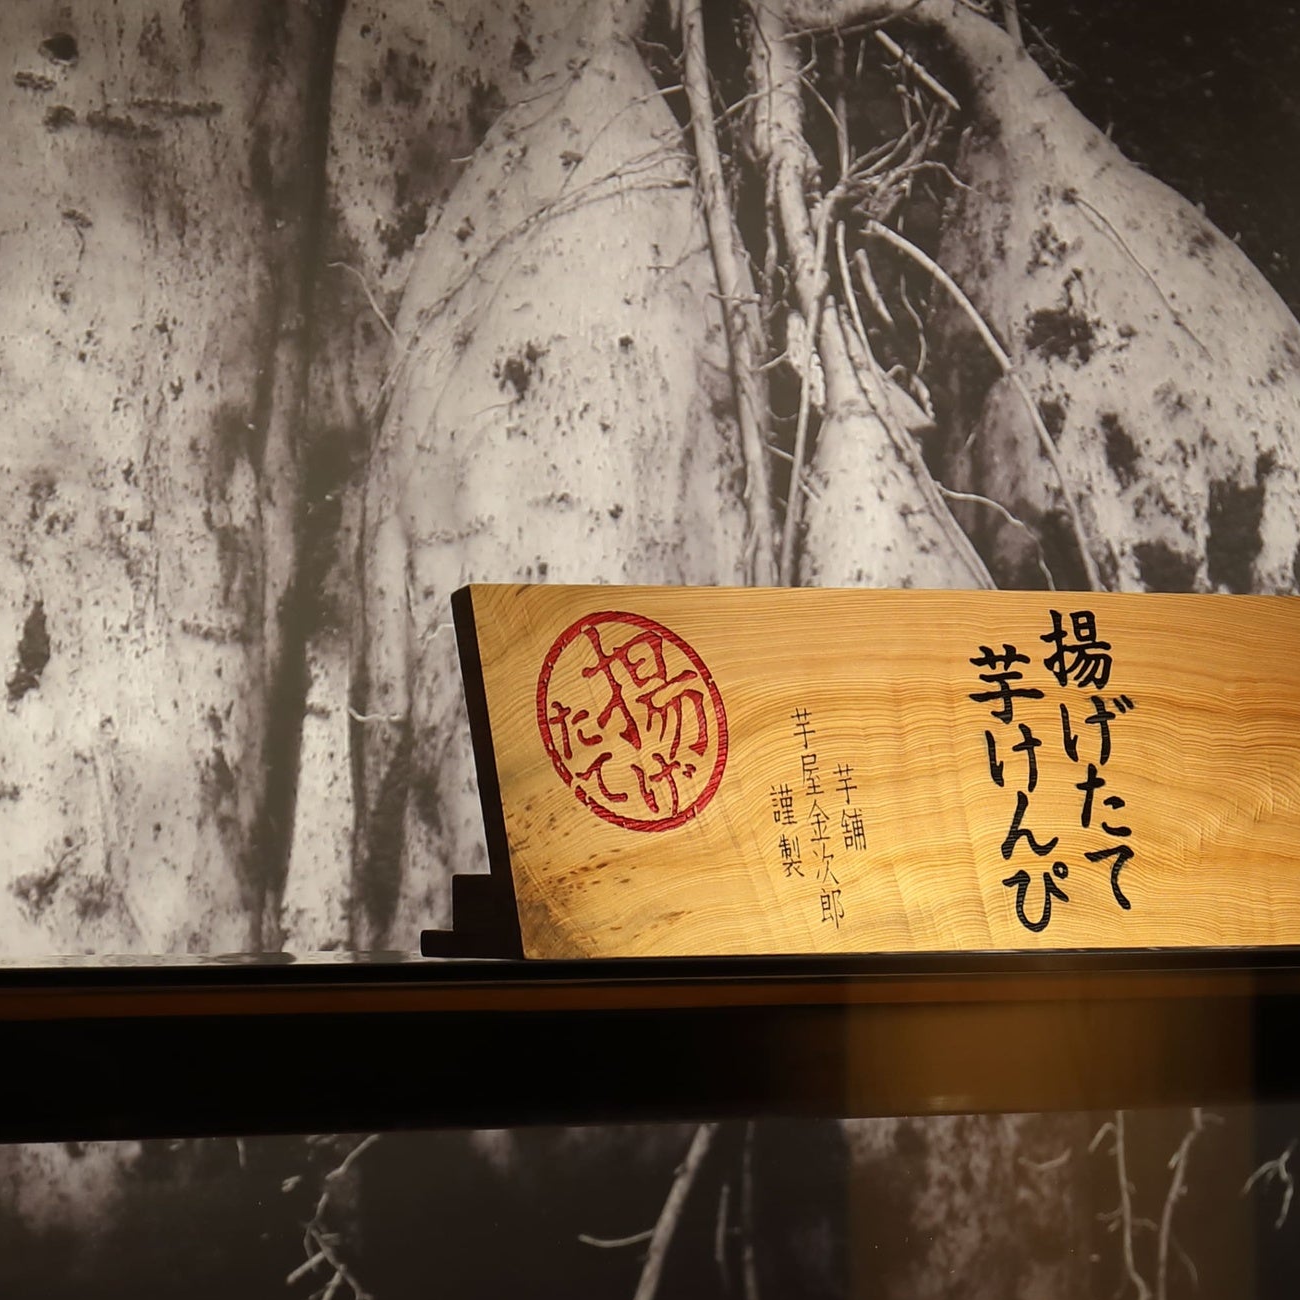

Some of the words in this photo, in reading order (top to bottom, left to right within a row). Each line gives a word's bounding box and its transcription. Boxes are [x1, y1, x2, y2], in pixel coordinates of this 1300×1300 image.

[548, 622, 709, 818] 揚げたて
[790, 707, 847, 930] 芋屋金次郎
[832, 763, 868, 852] 芋舗
[968, 643, 1071, 933] 芋けんぴ
[1040, 609, 1136, 911] 揚げたて
[769, 784, 806, 879] 謹製
